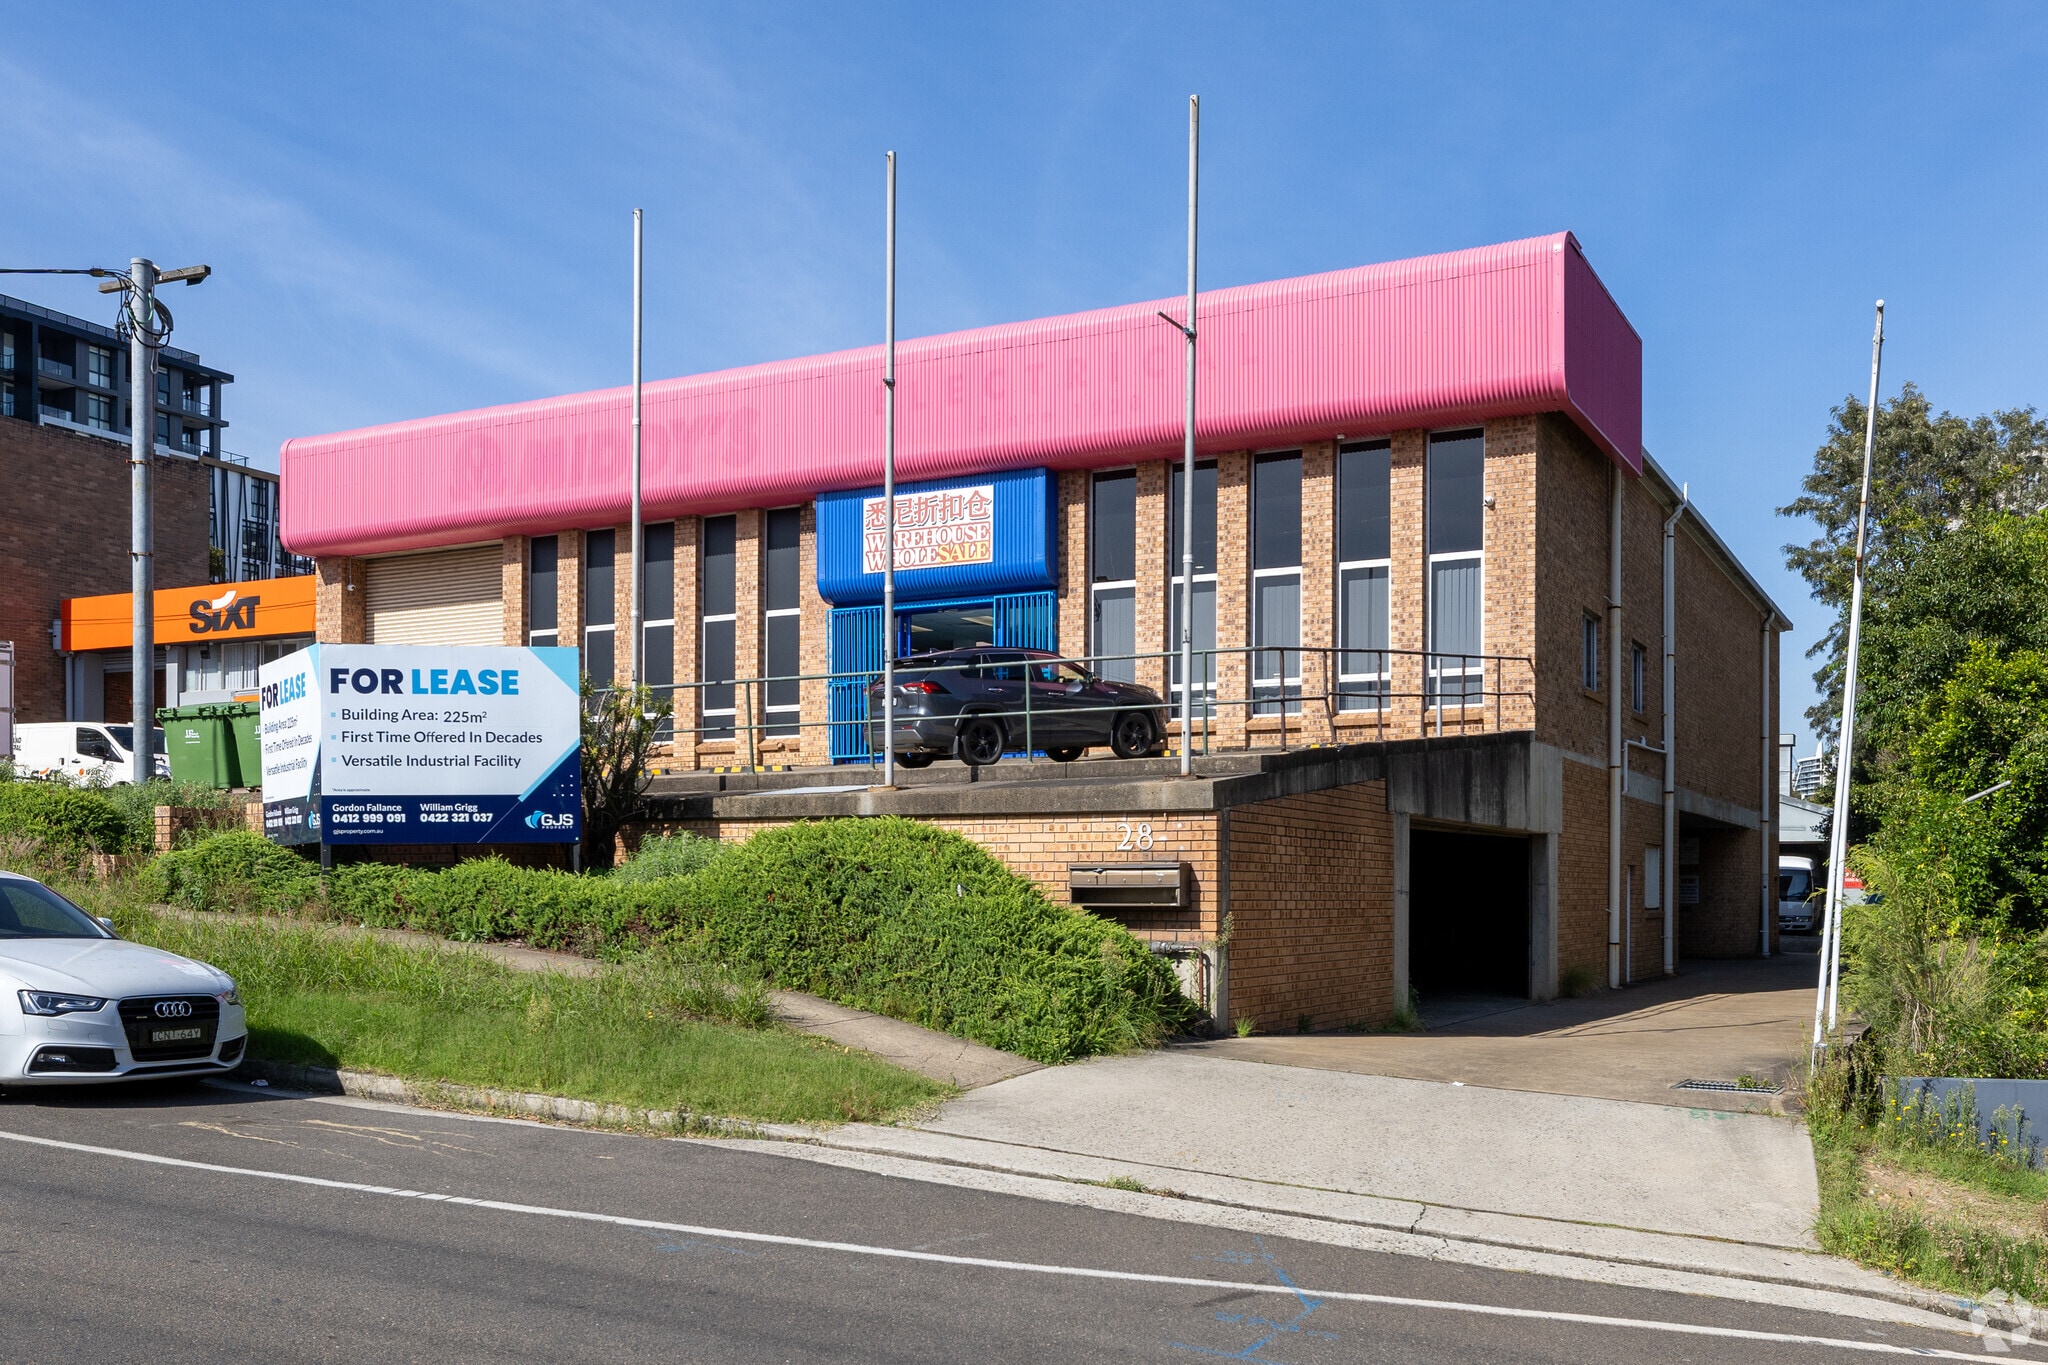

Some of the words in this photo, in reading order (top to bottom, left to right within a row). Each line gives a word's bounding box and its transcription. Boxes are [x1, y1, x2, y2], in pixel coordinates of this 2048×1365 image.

[865, 490, 992, 530] 悉尼折扣仓
[330, 668, 404, 694] FOR
[411, 669, 519, 695] LEASE
[261, 683, 278, 711] FOR
[280, 672, 306, 705] LEASE
[341, 708, 399, 723] Building
[401, 708, 438, 721] Area:
[341, 731, 374, 743] First
[376, 731, 411, 743] Time
[414, 731, 466, 743] Offered
[470, 731, 482, 743] In
[485, 731, 543, 743] Decades
[341, 754, 403, 767] Versatile
[406, 754, 470, 767] Industrial
[474, 754, 521, 769] Facility
[332, 803, 365, 812] Gordon
[366, 803, 402, 812] Fallance
[420, 803, 453, 811] William
[454, 803, 478, 813] Grigg
[332, 813, 360, 823] 0412
[362, 813, 384, 823] 999
[386, 813, 406, 823] 091
[420, 813, 449, 823] 0422
[451, 813, 470, 823] 321
[472, 813, 493, 823] 037
[541, 813, 574, 826] GJS
[1117, 822, 1154, 851] 28
